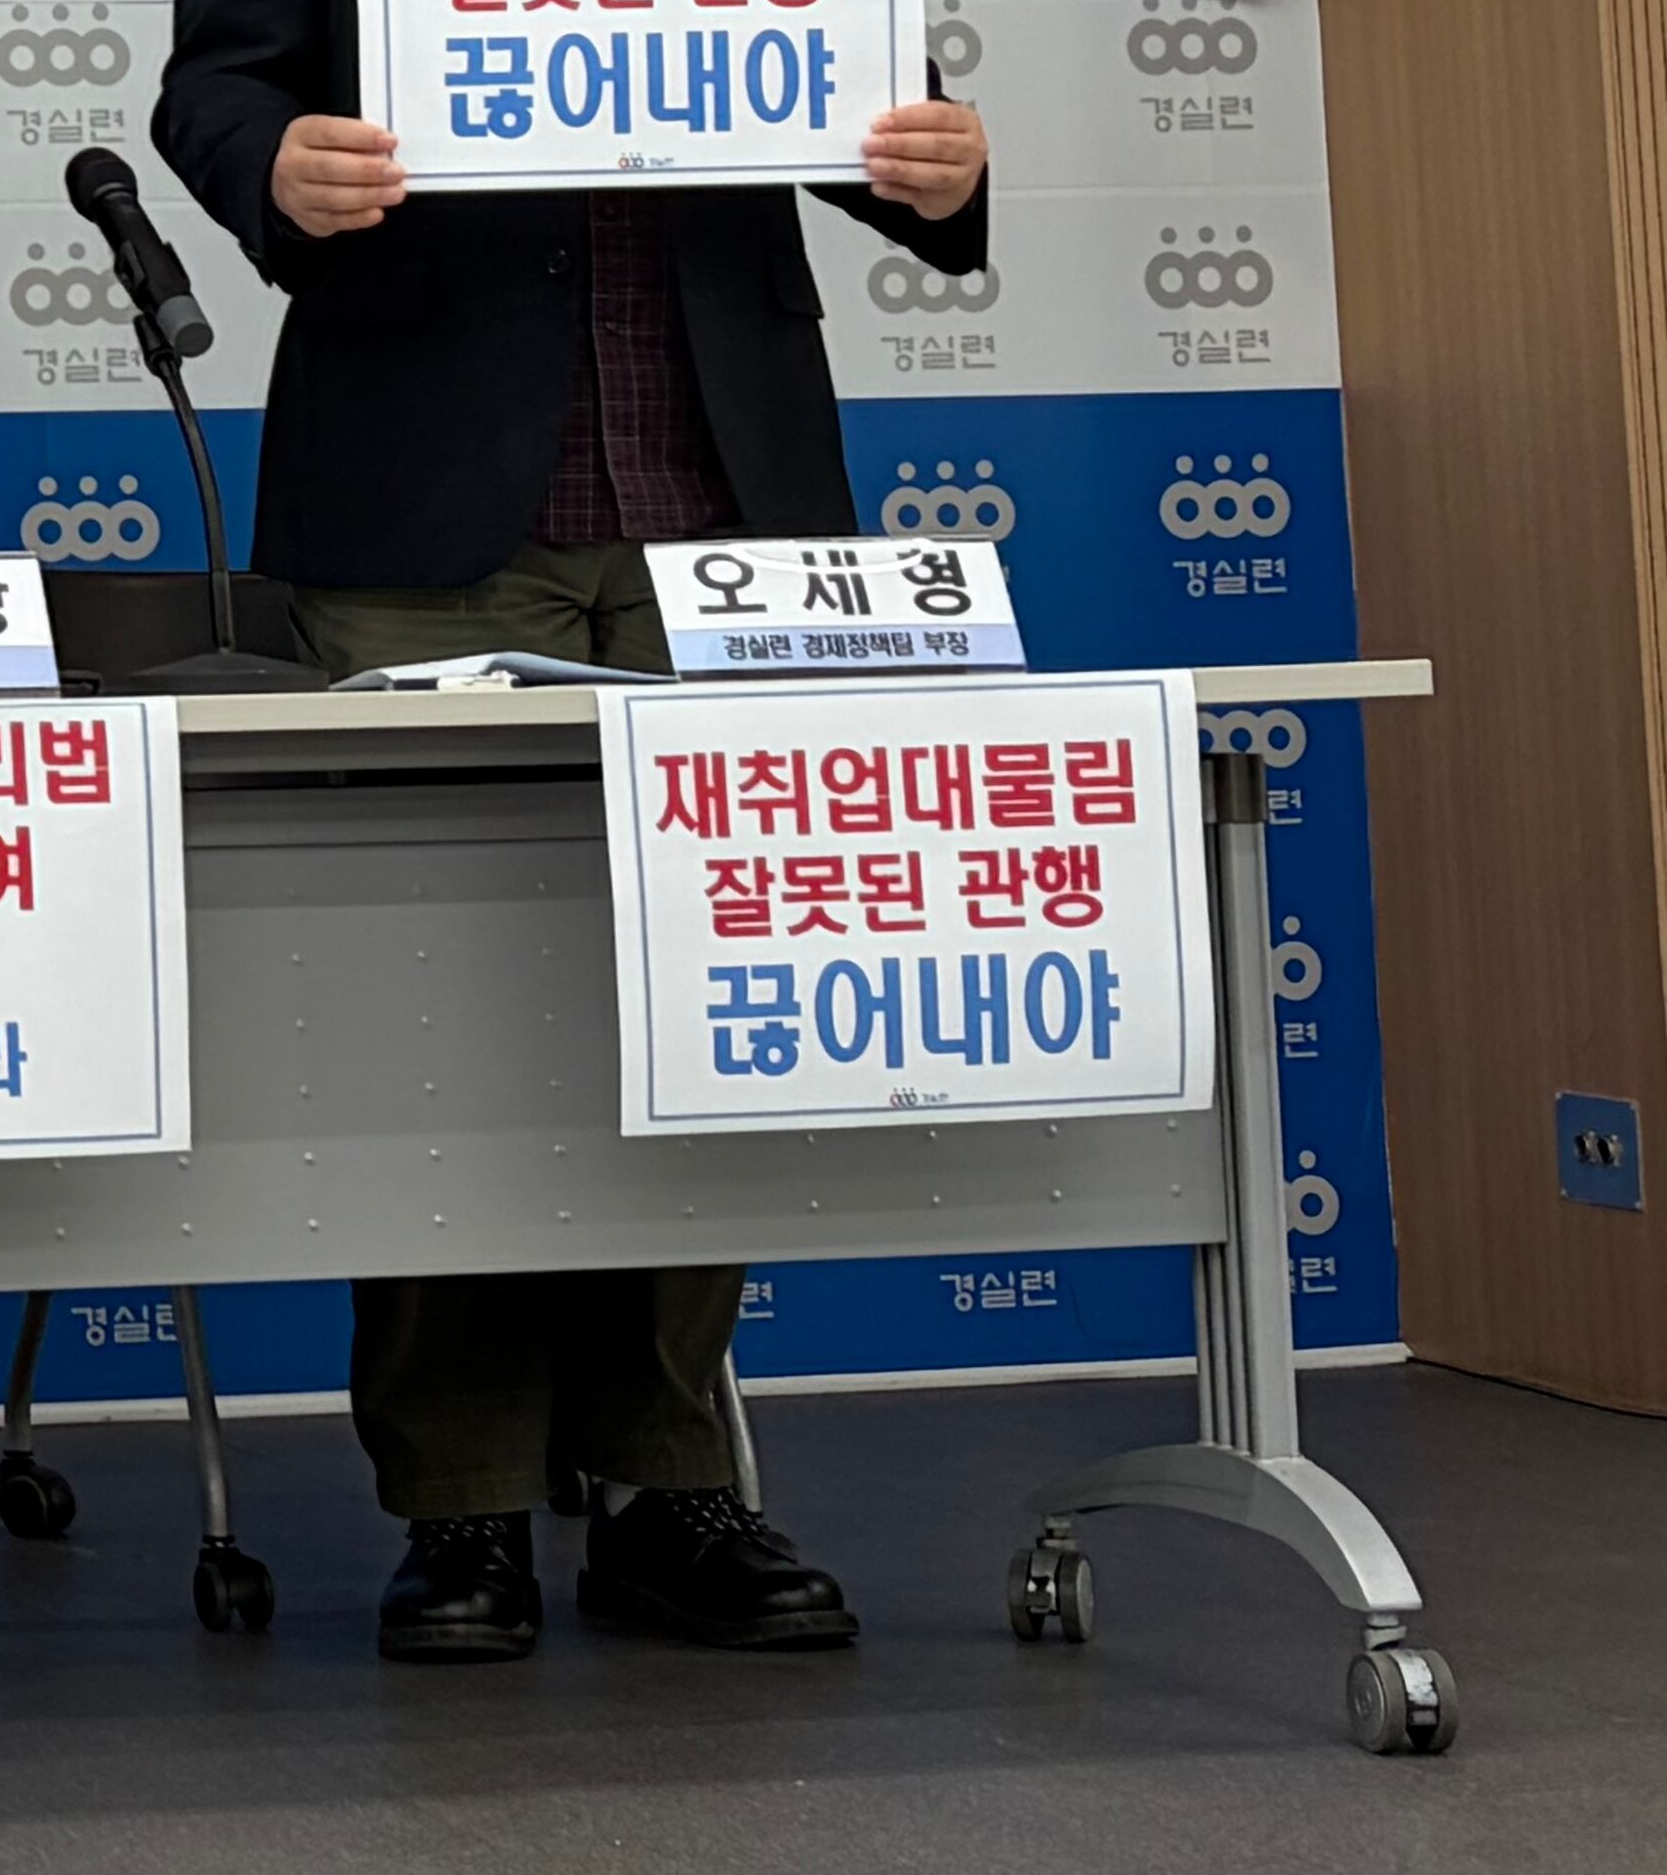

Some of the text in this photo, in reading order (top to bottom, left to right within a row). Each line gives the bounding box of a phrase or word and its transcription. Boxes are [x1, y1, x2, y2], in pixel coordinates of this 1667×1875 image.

[443, 28, 837, 140] 끊어내야
[7, 108, 126, 147] 경실련
[1140, 96, 1254, 133] 경실련
[22, 347, 142, 386] 경실련
[880, 333, 996, 371] 경실련
[1157, 329, 1271, 367] 경실련
[1173, 557, 1287, 597] 경실련
[723, 634, 792, 660] 경실련
[923, 631, 969, 656] 부장
[654, 737, 1137, 840] 재취업대물림
[704, 843, 1105, 938] 잘못된 관행
[706, 948, 1121, 1077] 끊어내야
[939, 1270, 1057, 1312] 경실련
